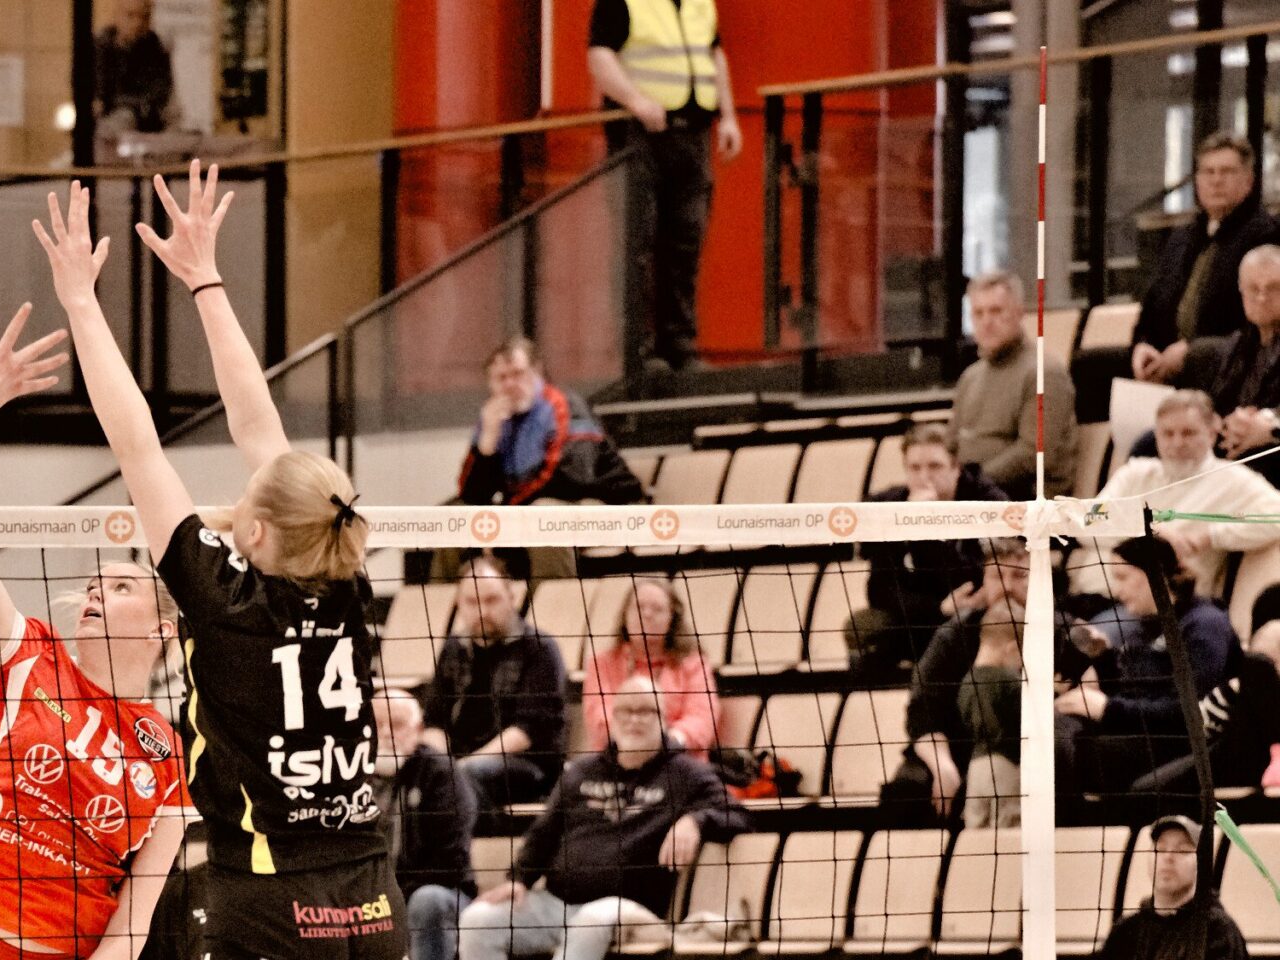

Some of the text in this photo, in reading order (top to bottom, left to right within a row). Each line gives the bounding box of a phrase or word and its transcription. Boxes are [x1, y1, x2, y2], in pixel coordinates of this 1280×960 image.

[81, 519, 100, 533] OP
[368, 519, 466, 533] ounaismaan OP
[538, 517, 645, 532] Lounaismaan OP
[716, 515, 823, 529] Lounaismaan OP
[894, 512, 978, 526] Lounaismaan
[271, 637, 363, 731] 14
[65, 705, 128, 786] 15
